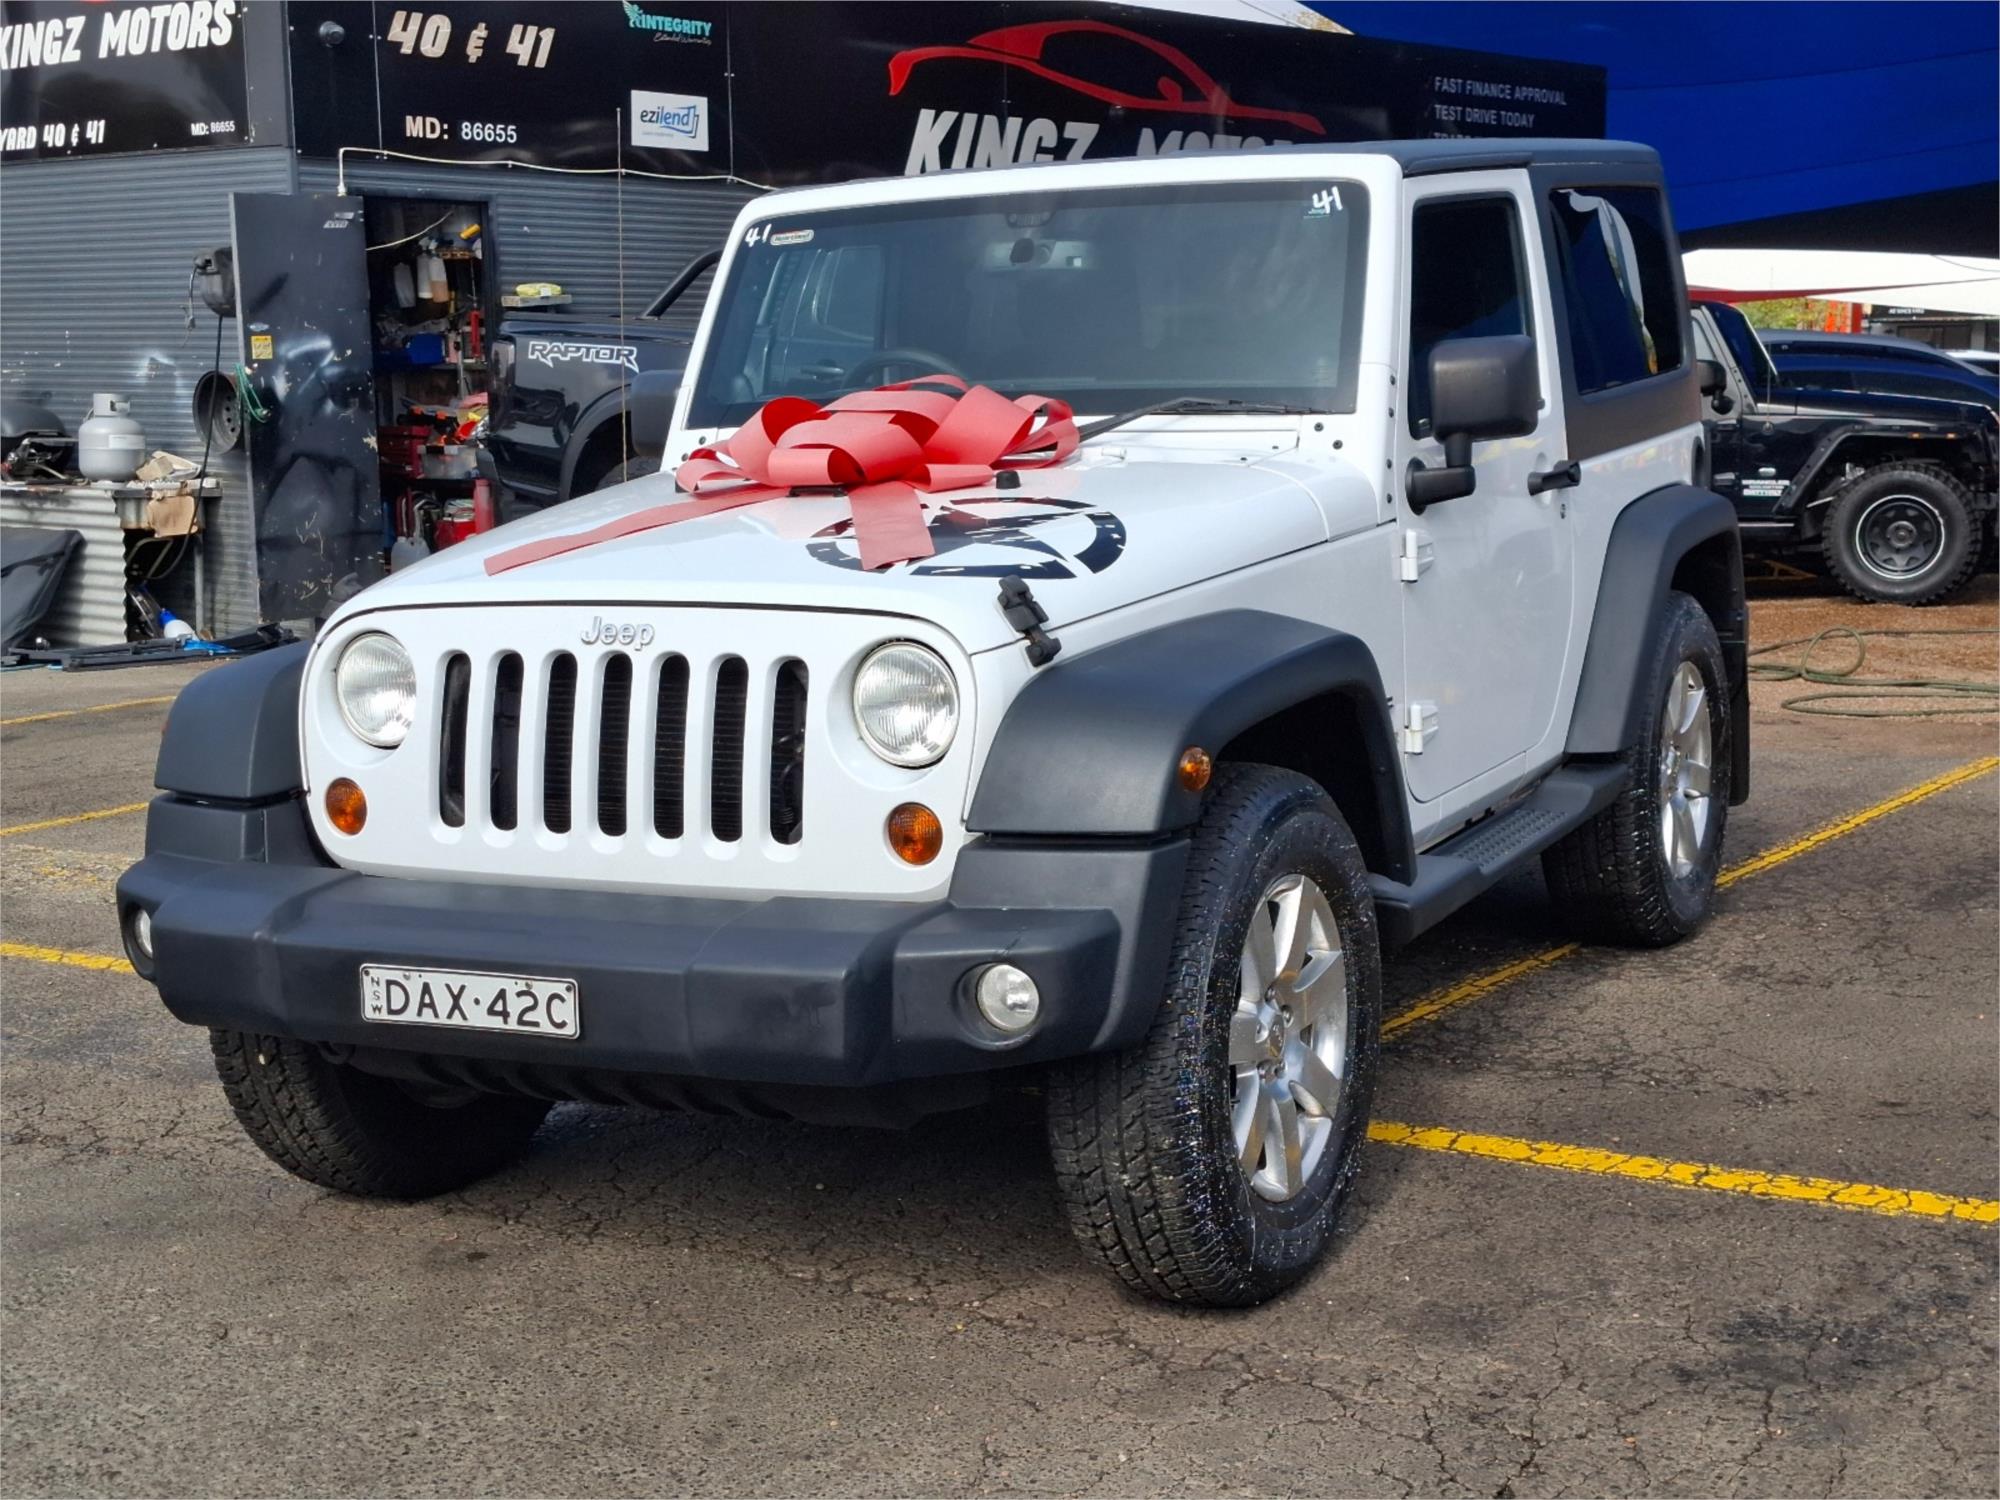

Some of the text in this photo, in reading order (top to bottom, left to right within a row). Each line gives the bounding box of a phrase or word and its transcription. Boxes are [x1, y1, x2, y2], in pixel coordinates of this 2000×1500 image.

[98, 0, 236, 59] MOTORS
[387, 10, 452, 58] 40
[505, 24, 556, 68] 41
[642, 14, 712, 36] INTEGRITY
[1434, 76, 1567, 105] FAST FINANCE APPROVAL
[191, 120, 235, 136] MD: 86655
[405, 115, 517, 143] MD: 86655
[640, 106, 691, 127] ezilend
[1434, 104, 1535, 128] TEST DRIVE TODAY
[0, 126, 37, 151] YARD
[43, 123, 65, 147] 40
[86, 119, 106, 144] 41
[1312, 185, 1343, 214] 41
[745, 223, 772, 247] 41
[528, 341, 640, 374] RAPTOR
[580, 615, 655, 652] Jeep
